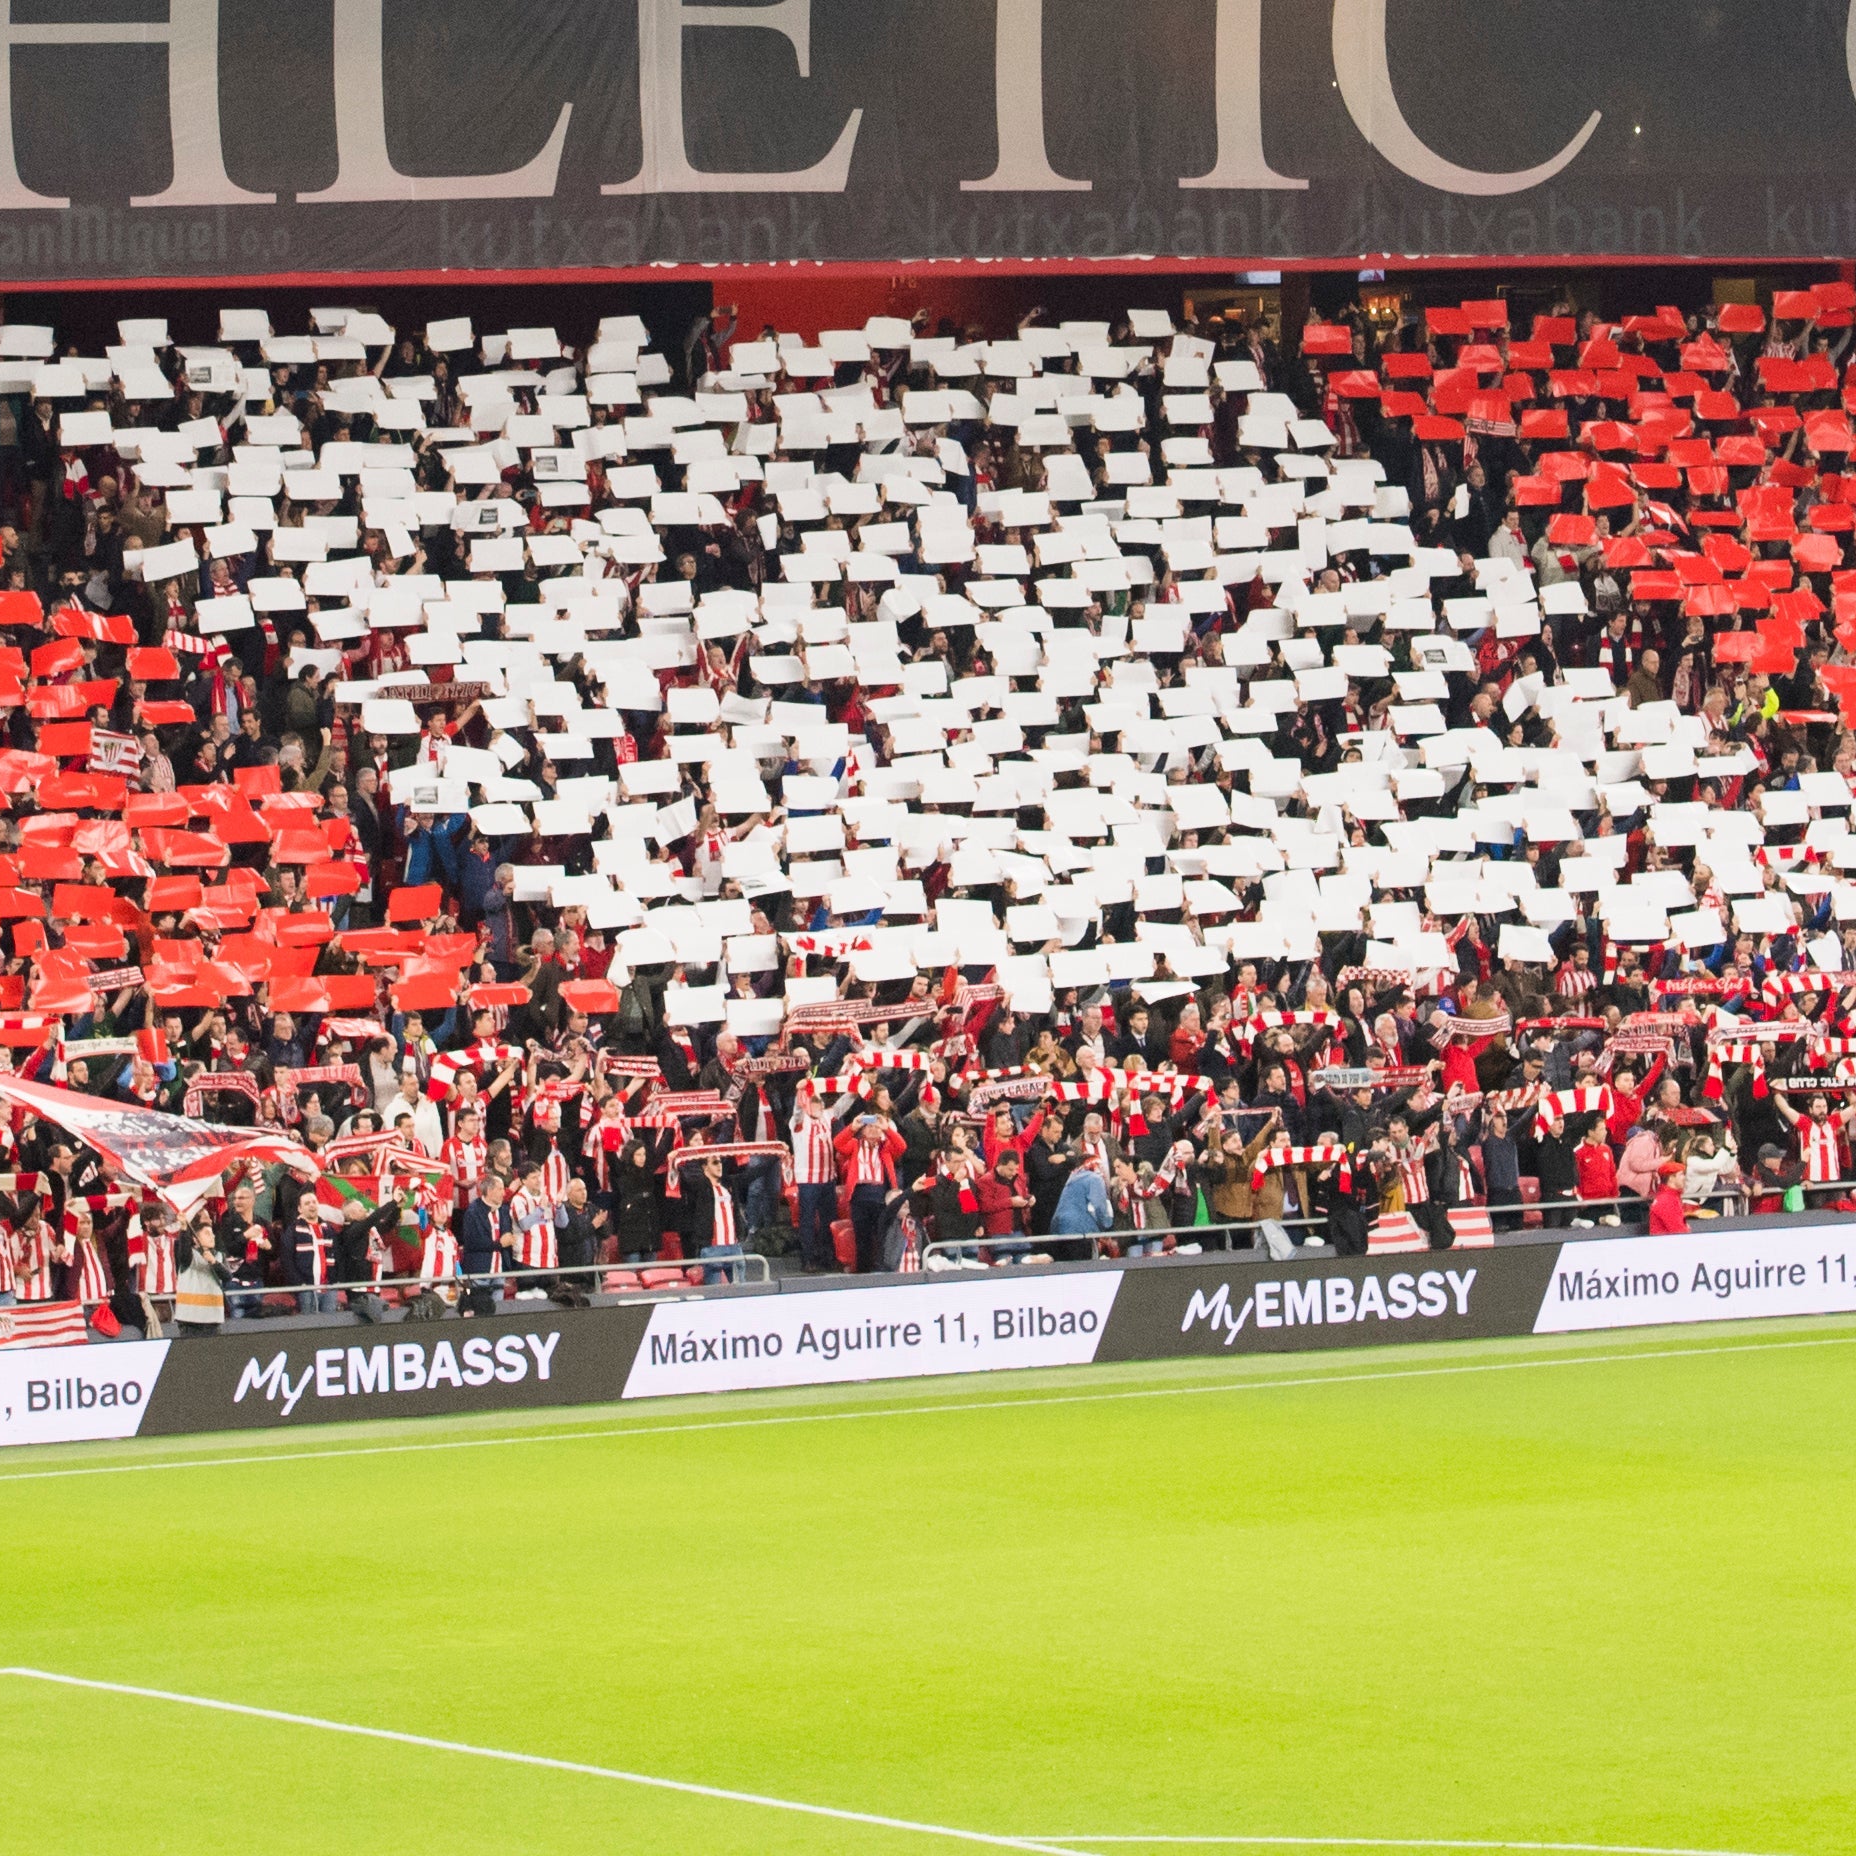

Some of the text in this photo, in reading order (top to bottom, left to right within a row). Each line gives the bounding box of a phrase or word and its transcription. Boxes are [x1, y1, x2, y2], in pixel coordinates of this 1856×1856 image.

[1559, 1270, 1679, 1302] Máximo
[1692, 1262, 1806, 1298] Aguirre
[651, 1306, 1098, 1366] Máximo Aguirre 11, Bilbao
[28, 1377, 142, 1412] Bilbao
